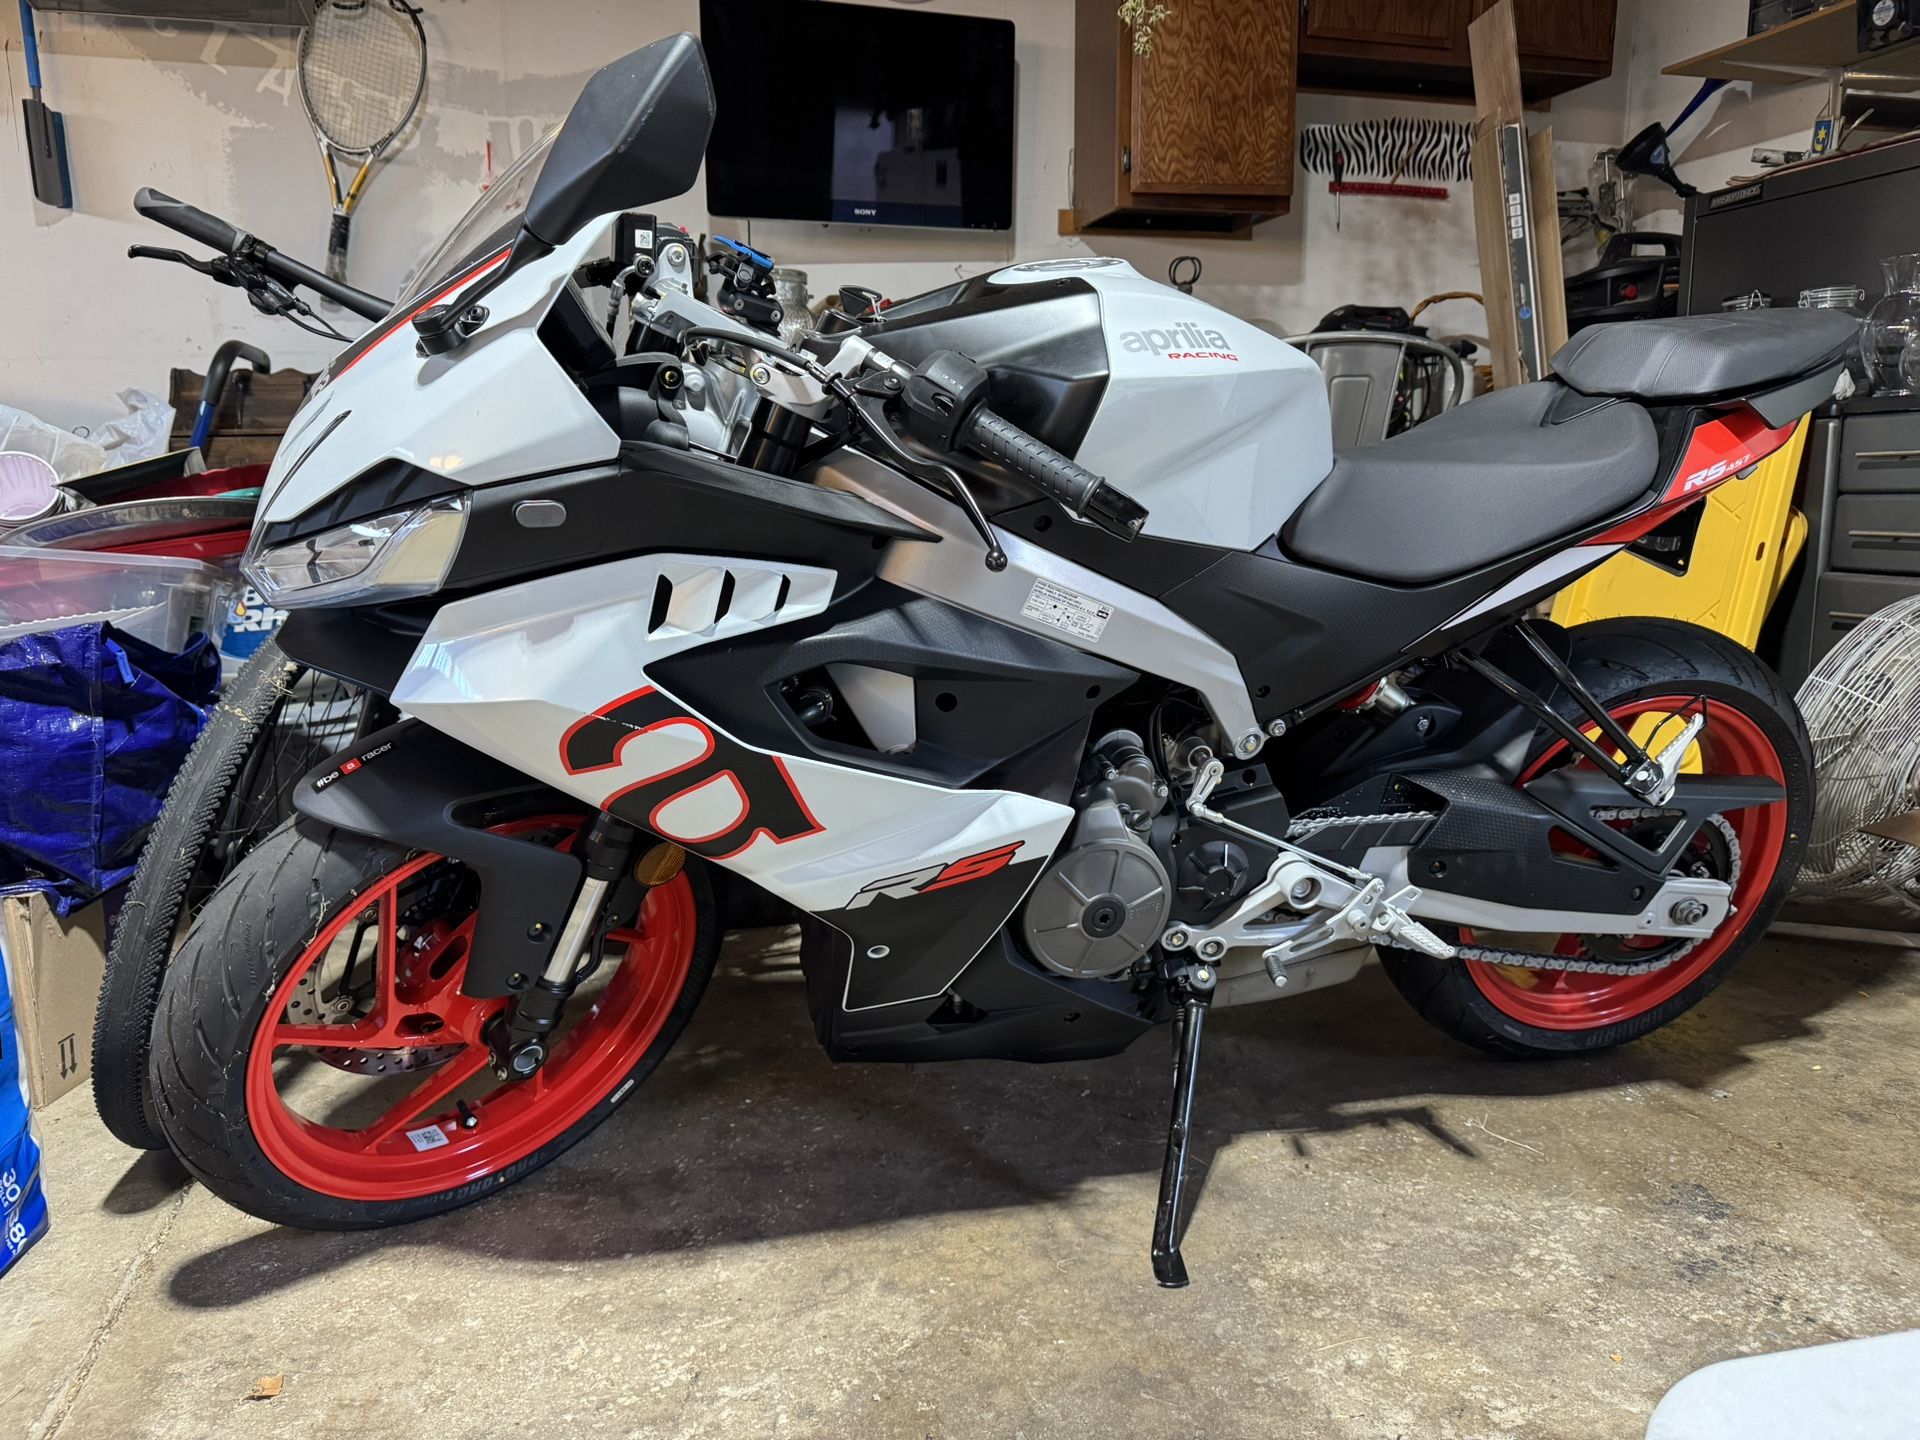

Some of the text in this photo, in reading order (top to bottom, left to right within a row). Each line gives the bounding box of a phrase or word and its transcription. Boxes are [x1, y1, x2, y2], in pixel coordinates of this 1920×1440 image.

[854, 208, 876, 217] SONY
[1120, 322, 1231, 356] aprilia
[1167, 352, 1239, 361] RACING
[316, 771, 339, 787] #be
[361, 742, 392, 761] racer
[844, 839, 1025, 911] RS
[3, 1168, 20, 1202] 30
